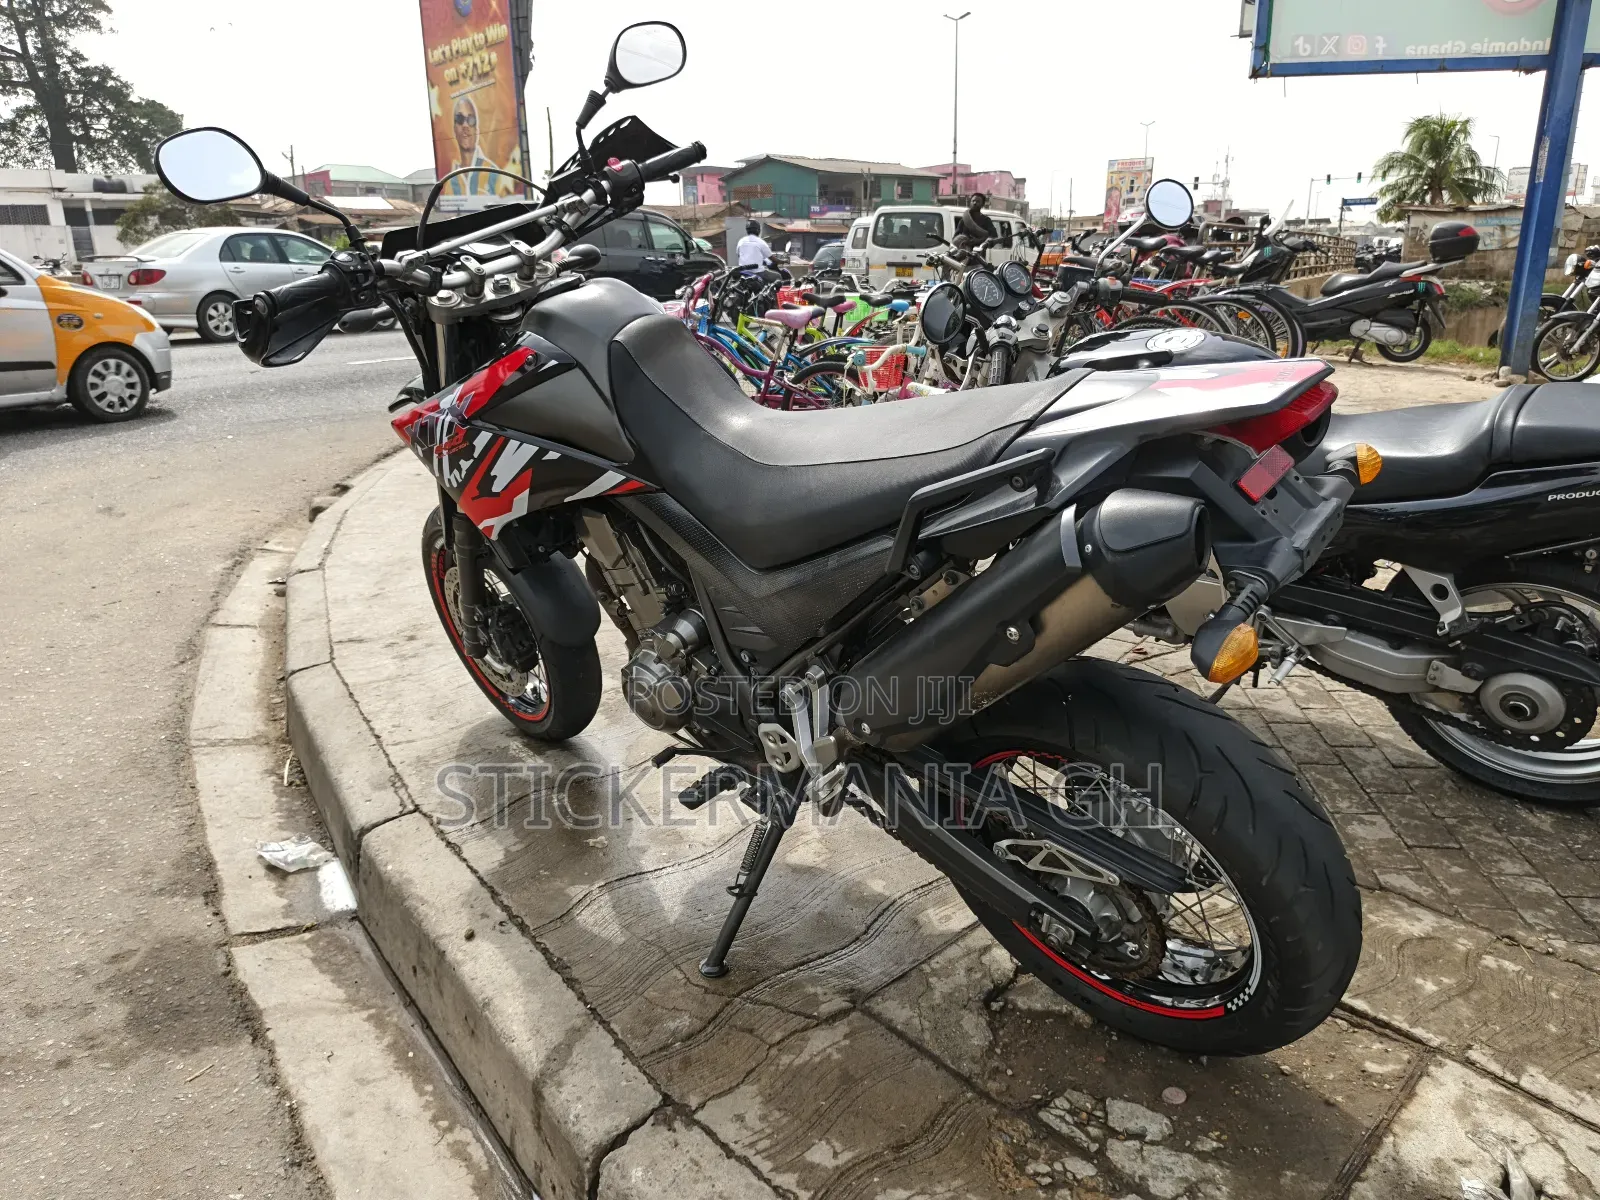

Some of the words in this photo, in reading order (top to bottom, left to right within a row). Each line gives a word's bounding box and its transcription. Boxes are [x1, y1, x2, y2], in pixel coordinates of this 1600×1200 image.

[452, 36, 474, 56] Play
[474, 32, 486, 49] to
[485, 23, 508, 46] Win
